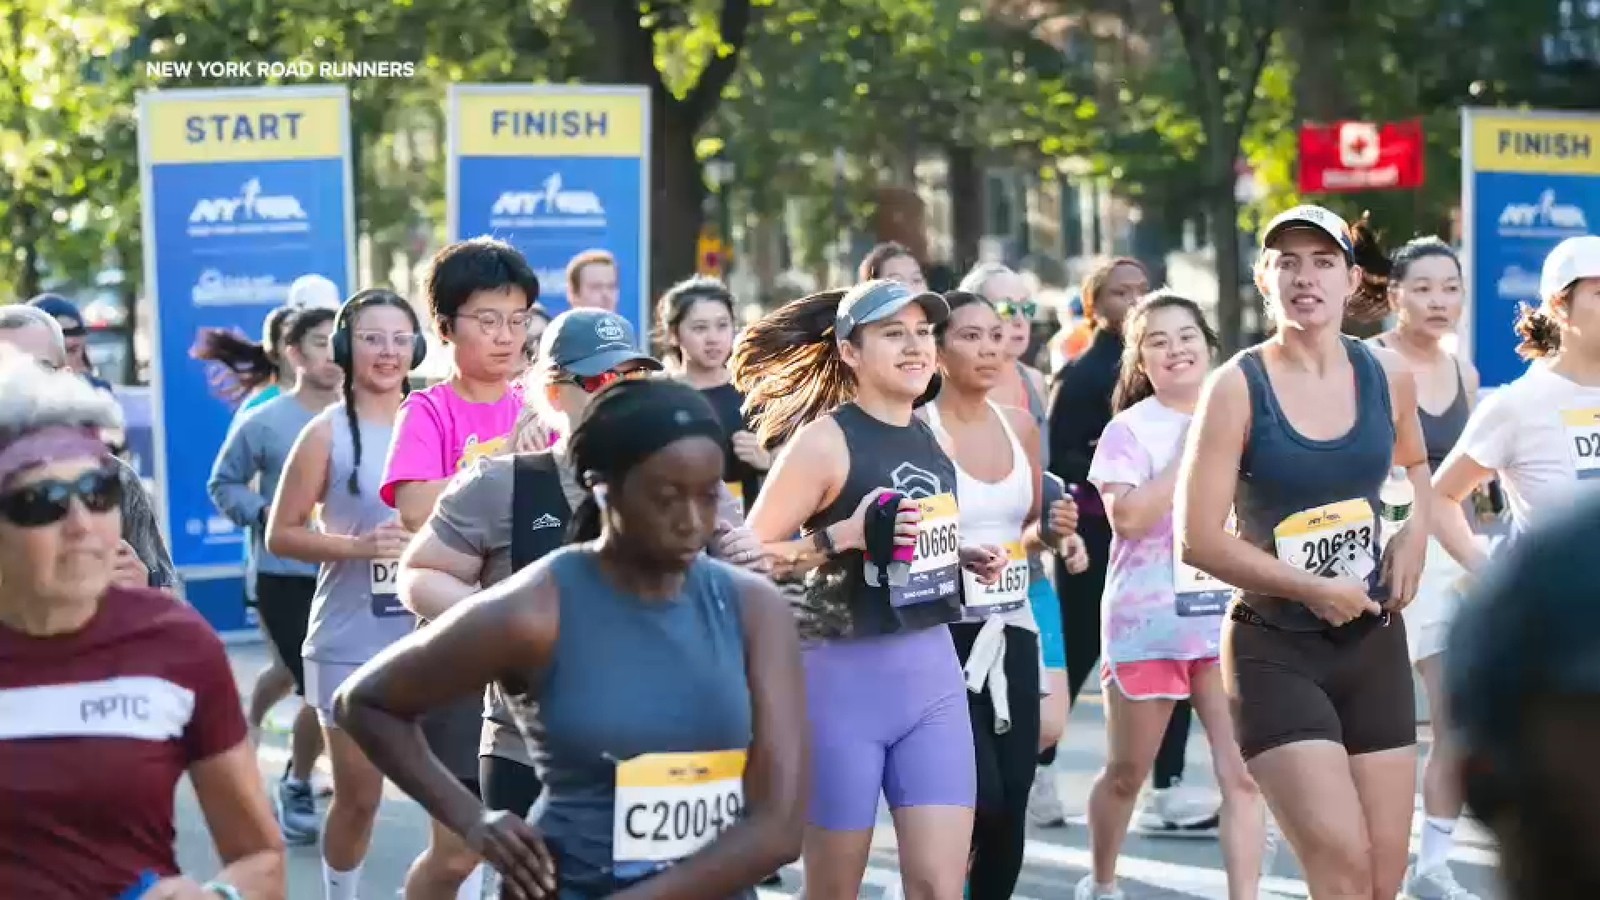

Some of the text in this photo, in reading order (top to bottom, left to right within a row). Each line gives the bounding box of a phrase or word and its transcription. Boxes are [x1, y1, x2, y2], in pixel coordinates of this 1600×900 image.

[185, 113, 305, 143] START
[491, 109, 609, 137] FINISH
[1497, 129, 1591, 160] FINISH
[913, 522, 957, 561] 0666
[985, 565, 1028, 593] 1657
[80, 693, 150, 722] PPTC
